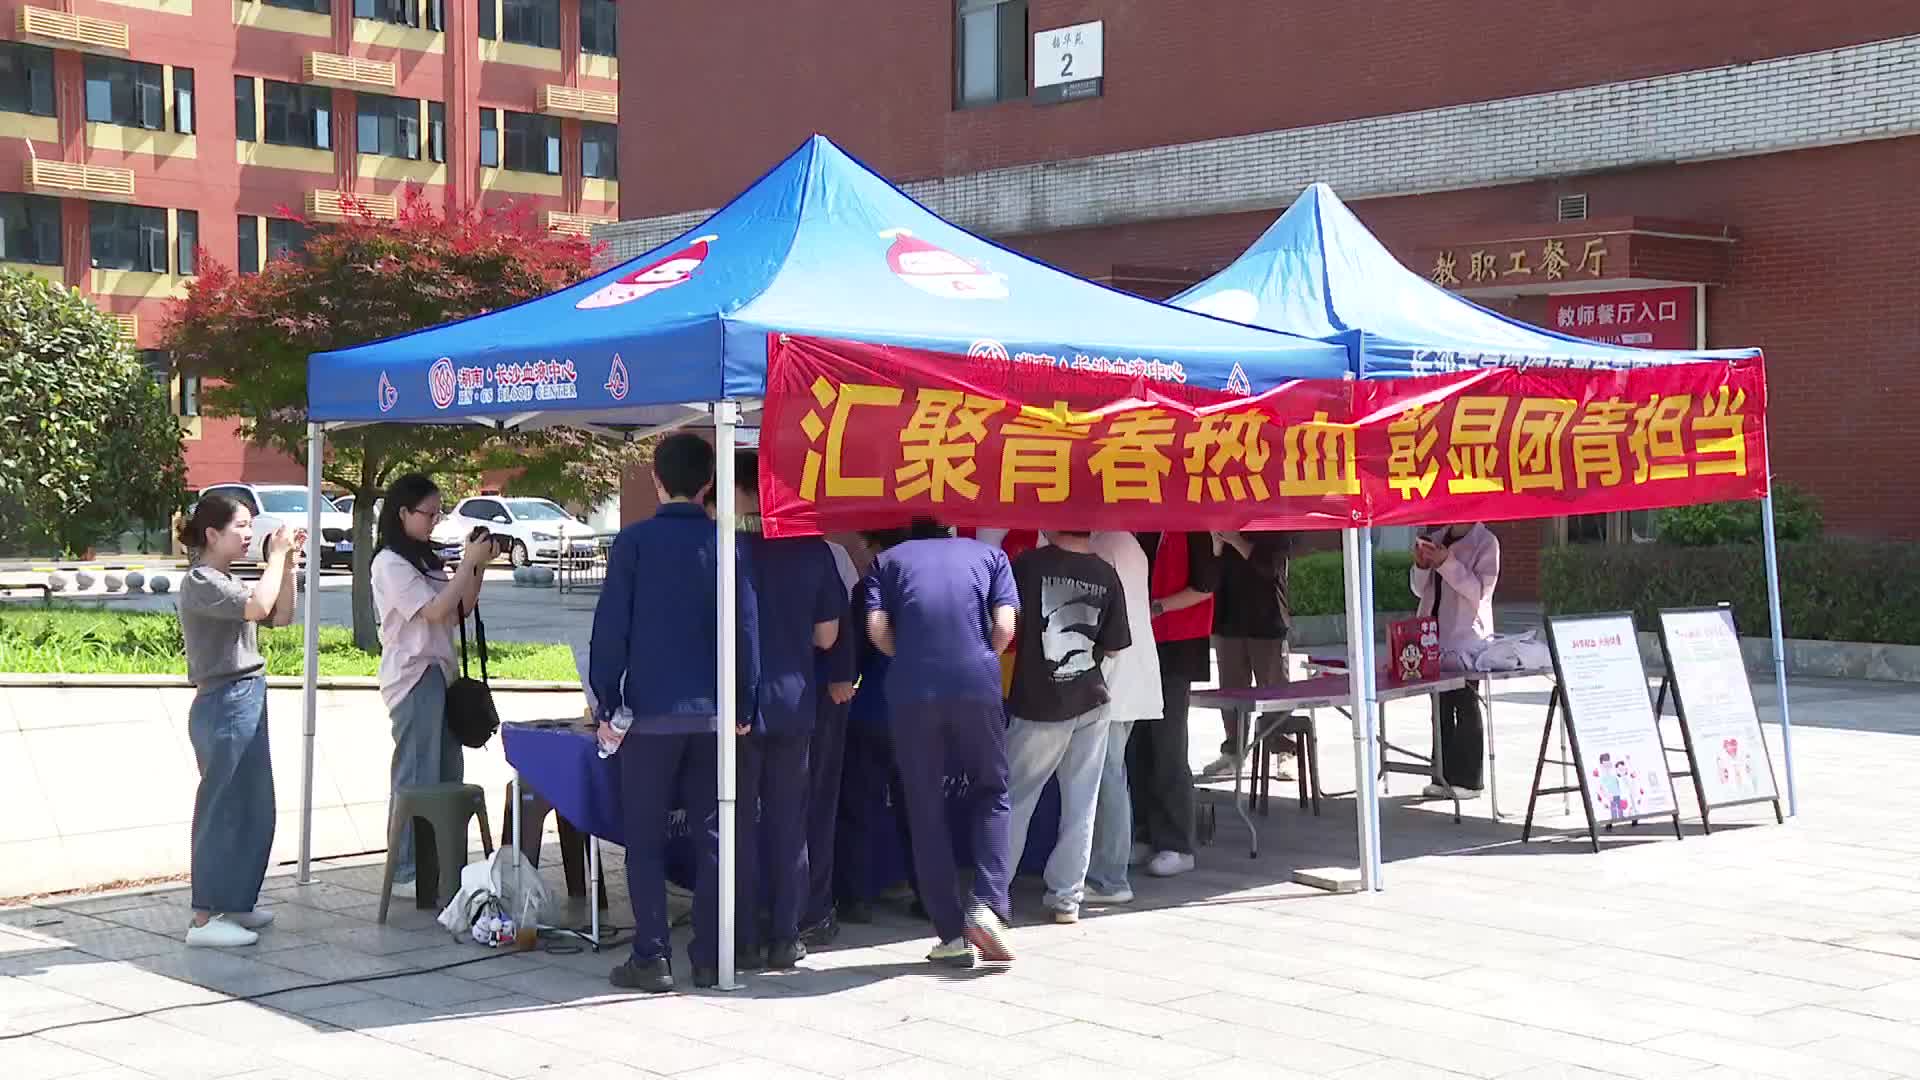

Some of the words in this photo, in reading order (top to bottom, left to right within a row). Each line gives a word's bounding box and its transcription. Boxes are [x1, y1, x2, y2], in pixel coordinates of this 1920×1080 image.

[1061, 53, 1073, 77] 2
[1431, 238, 1608, 287] 教职工餐厅
[1557, 301, 1676, 327] 教师餐厅入口
[497, 385, 533, 402] BLOOD
[535, 383, 577, 400] CENTER
[798, 375, 1361, 504] 汇聚青春热血
[1387, 385, 1748, 500] 彰显团青担当
